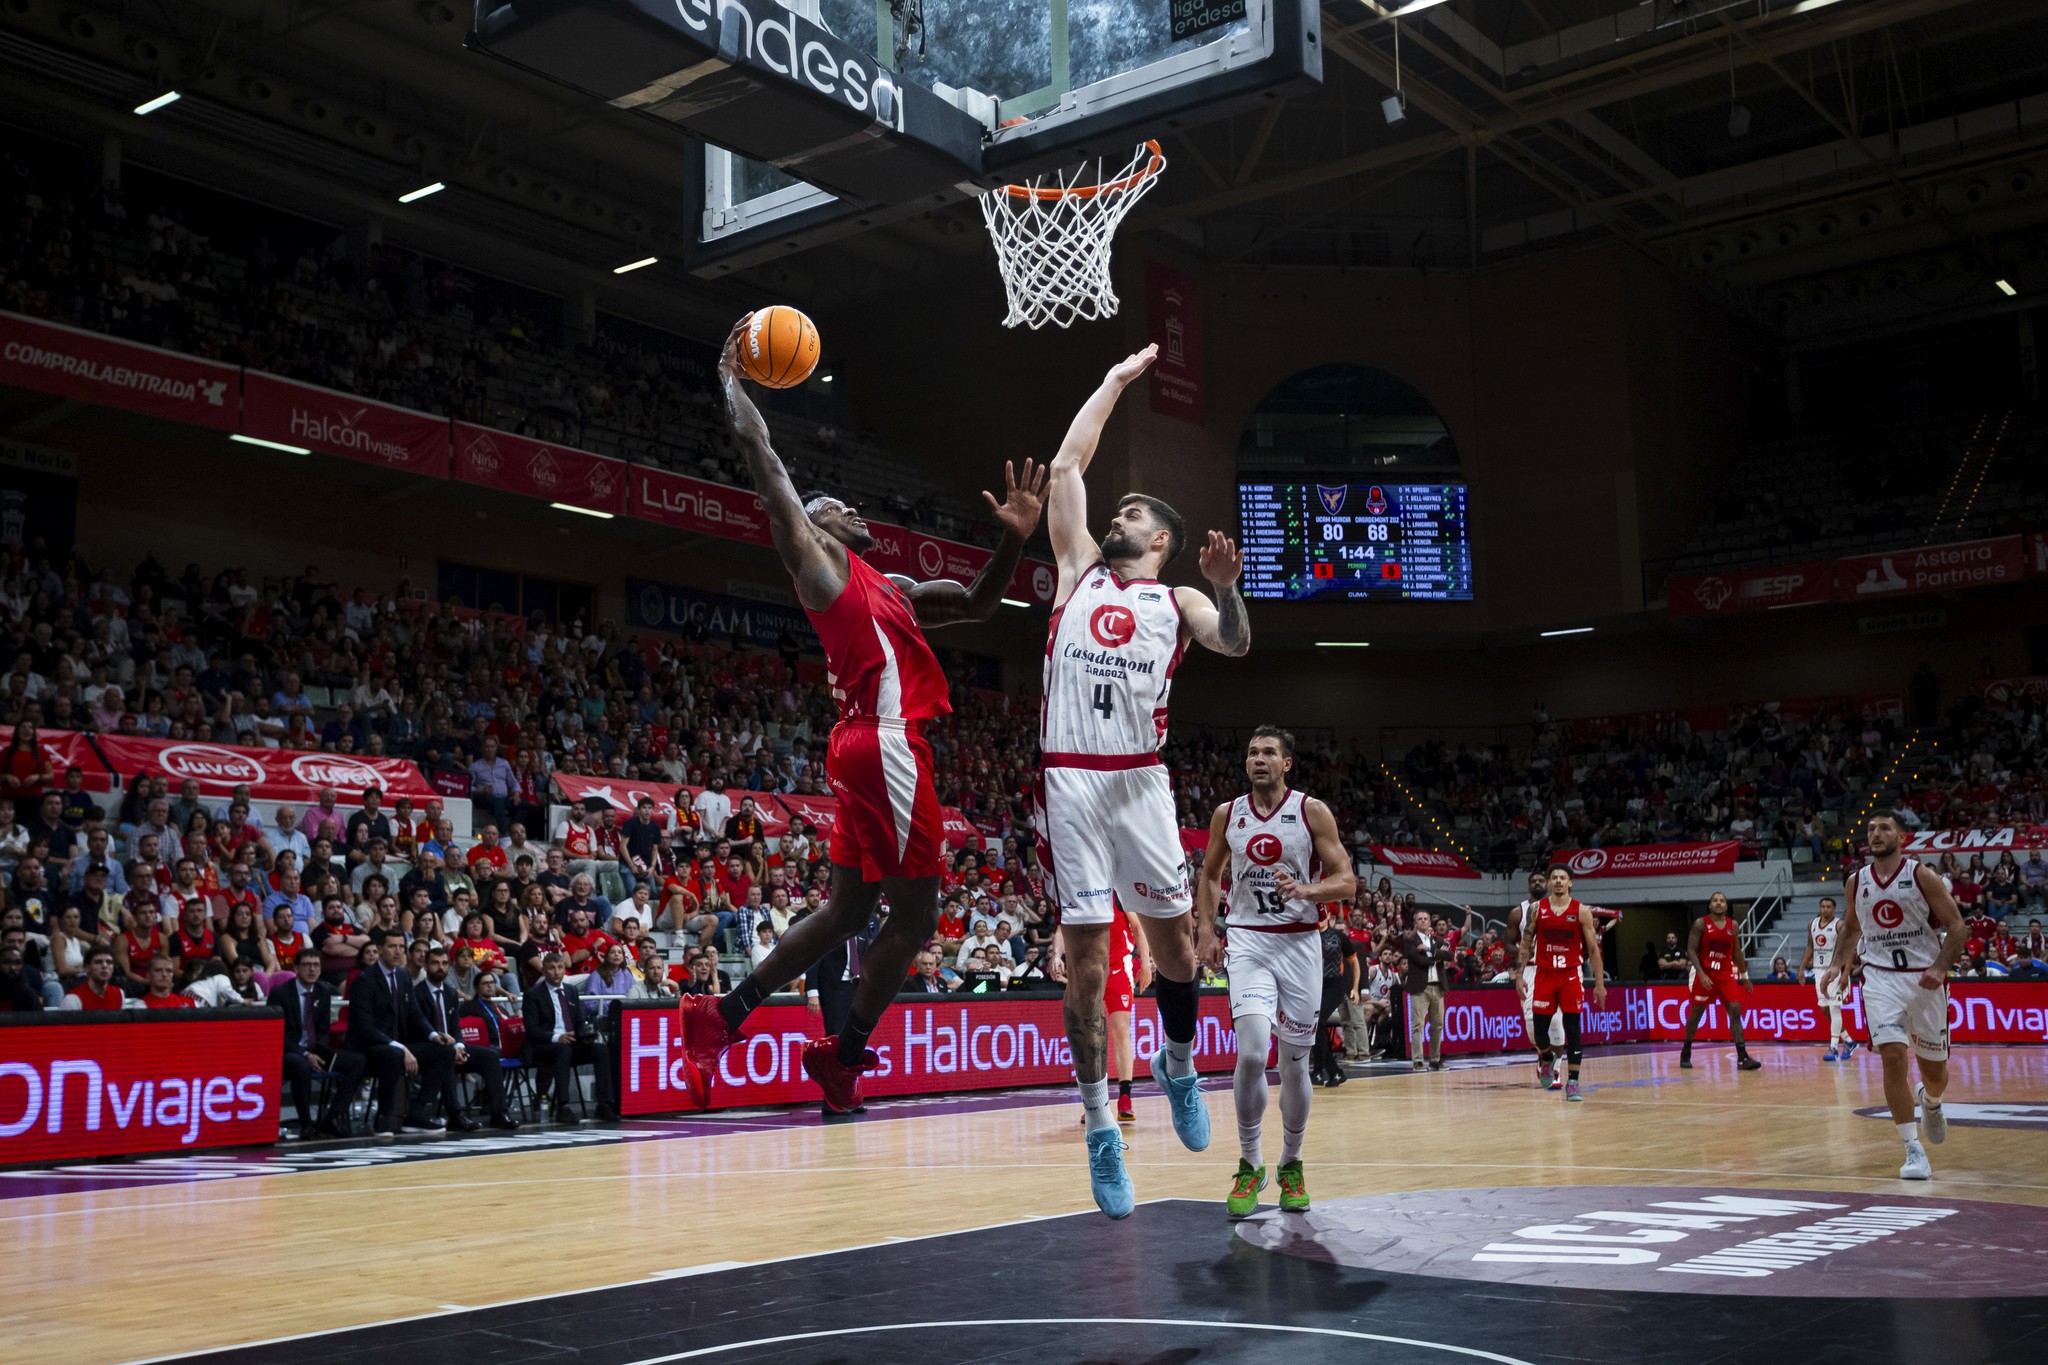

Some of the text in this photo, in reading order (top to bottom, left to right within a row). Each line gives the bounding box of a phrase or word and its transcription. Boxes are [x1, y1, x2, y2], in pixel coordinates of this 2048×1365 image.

[1174, 0, 1205, 18] liga
[1175, 0, 1244, 34] endesa
[676, 0, 905, 134] endesa
[3, 342, 197, 401] COMPRALAENTRADA
[370, 441, 409, 462] viajes
[643, 478, 723, 522] Lunia
[1323, 524, 1344, 541] 80
[1367, 524, 1388, 541] 68
[1338, 546, 1376, 560] 1:44
[1914, 545, 1992, 568] Asterra
[1354, 569, 1361, 579] 4
[1916, 564, 2007, 588] Partners
[1064, 642, 1158, 675] Casademont
[1093, 684, 1113, 719] 4
[178, 757, 251, 779] Juver
[307, 764, 375, 787] Juver
[1904, 827, 2015, 851] ZONA
[1611, 857, 1716, 871] Medioambientales
[1639, 848, 1719, 862] Soluciones
[1868, 926, 1925, 944] asademont
[1552, 954, 1567, 968] 12
[1819, 955, 1825, 965] 3
[1891, 948, 1908, 969] 0
[1483, 1014, 1522, 1048] viajes
[1589, 1010, 1622, 1042] viajes
[1740, 1008, 1818, 1040] viajes
[904, 1009, 1040, 1075] Halcon
[106, 1074, 265, 1145] viajes
[1471, 1195, 1851, 1265] UCAM
[1656, 1206, 1961, 1277] UNIVERSIDAD
